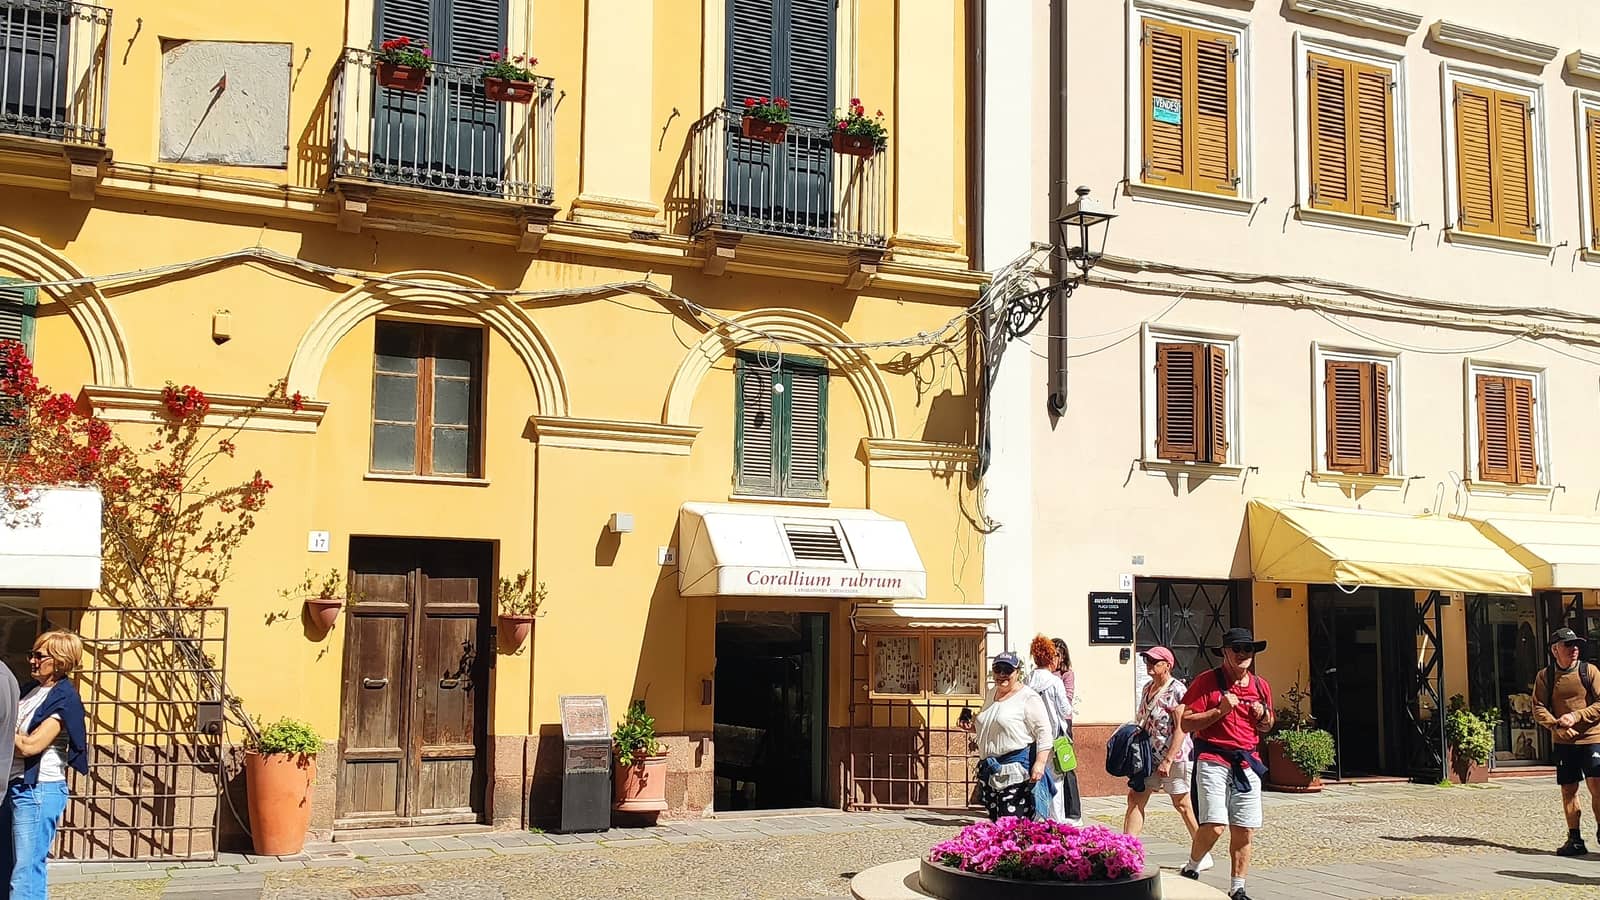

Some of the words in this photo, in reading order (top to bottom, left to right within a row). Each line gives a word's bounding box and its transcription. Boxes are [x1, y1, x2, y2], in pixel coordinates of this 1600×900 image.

[1154, 97, 1180, 113] VENDESI
[315, 538, 326, 547] 17
[746, 570, 831, 587] Corallium
[840, 572, 902, 588] rubrum
